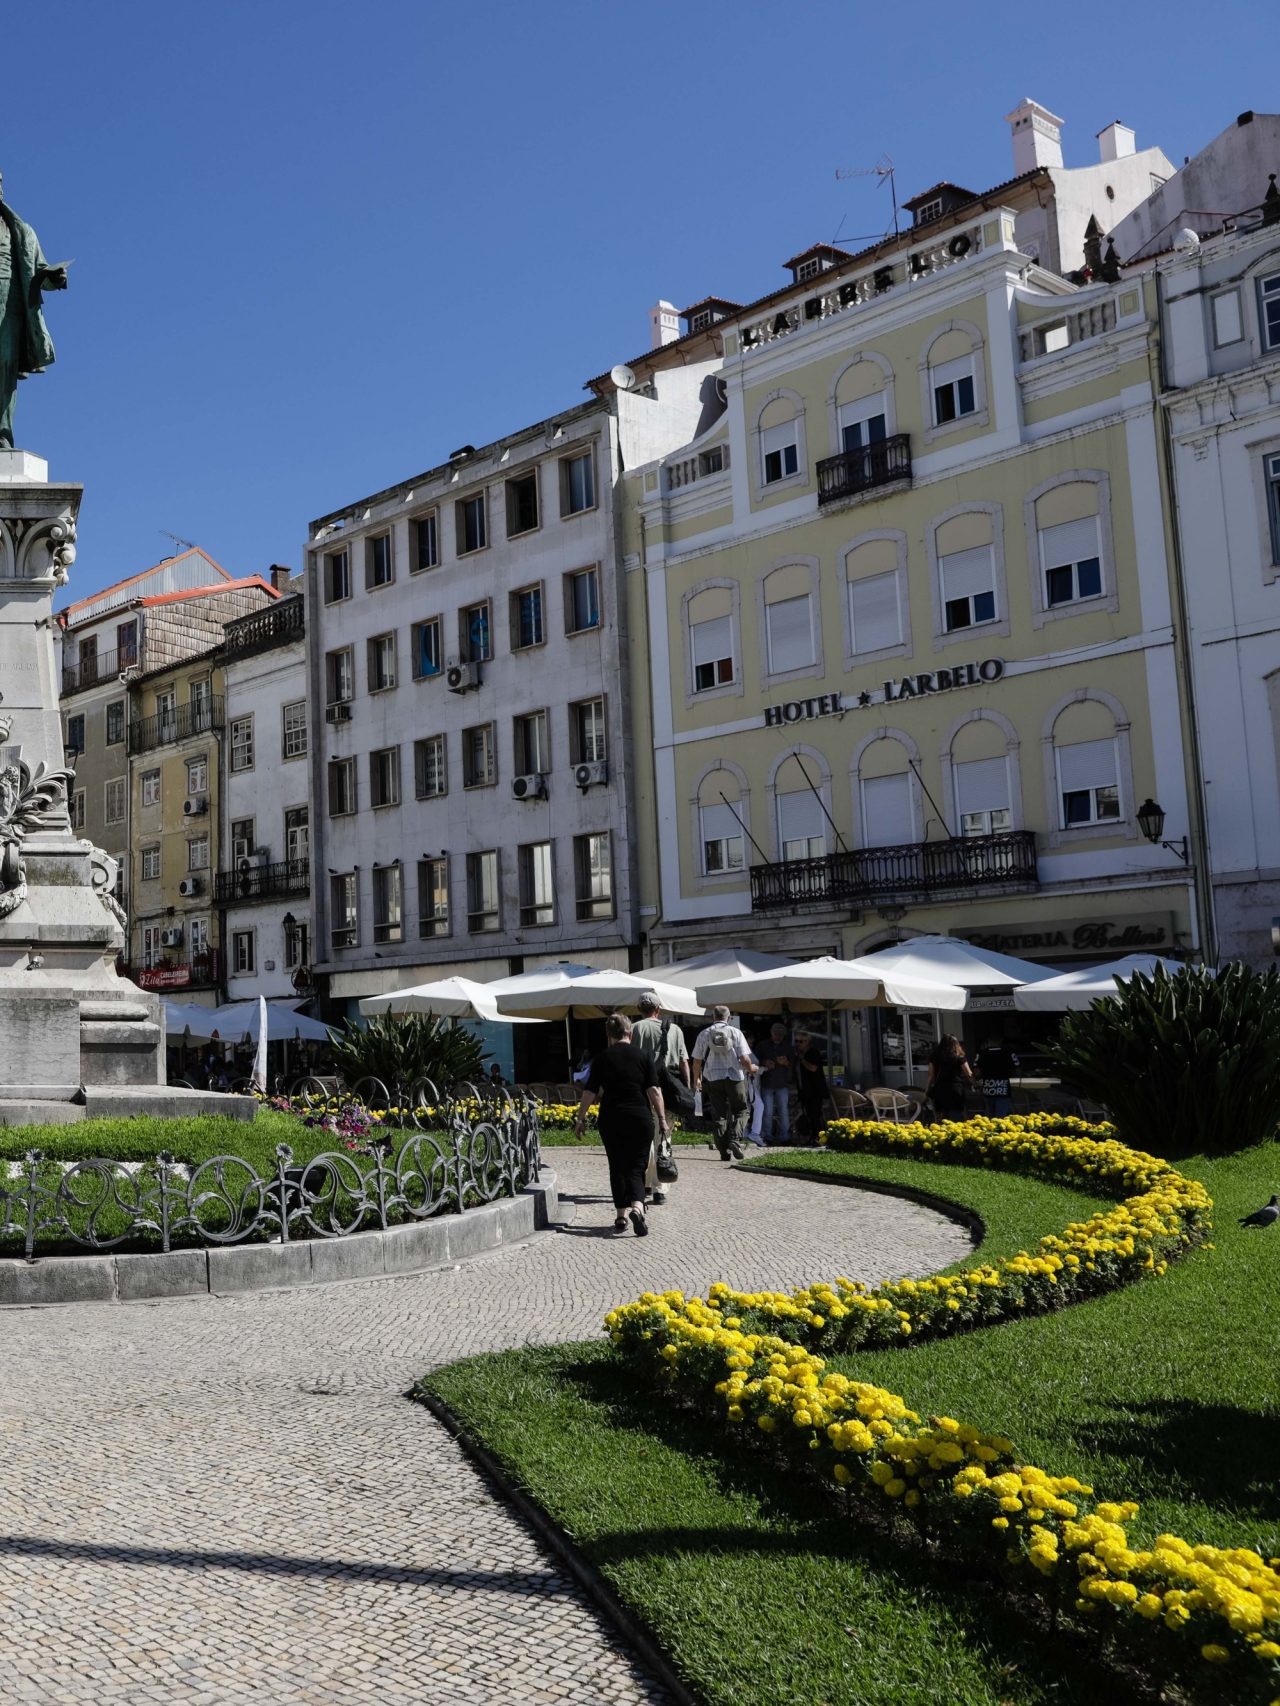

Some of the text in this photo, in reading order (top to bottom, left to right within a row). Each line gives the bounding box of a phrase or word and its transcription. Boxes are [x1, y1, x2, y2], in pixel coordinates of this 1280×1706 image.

[763, 656, 1006, 728] HOTEL LARBELO
[1072, 922, 1167, 950] Bellini
[983, 1079, 1009, 1088] SOME
